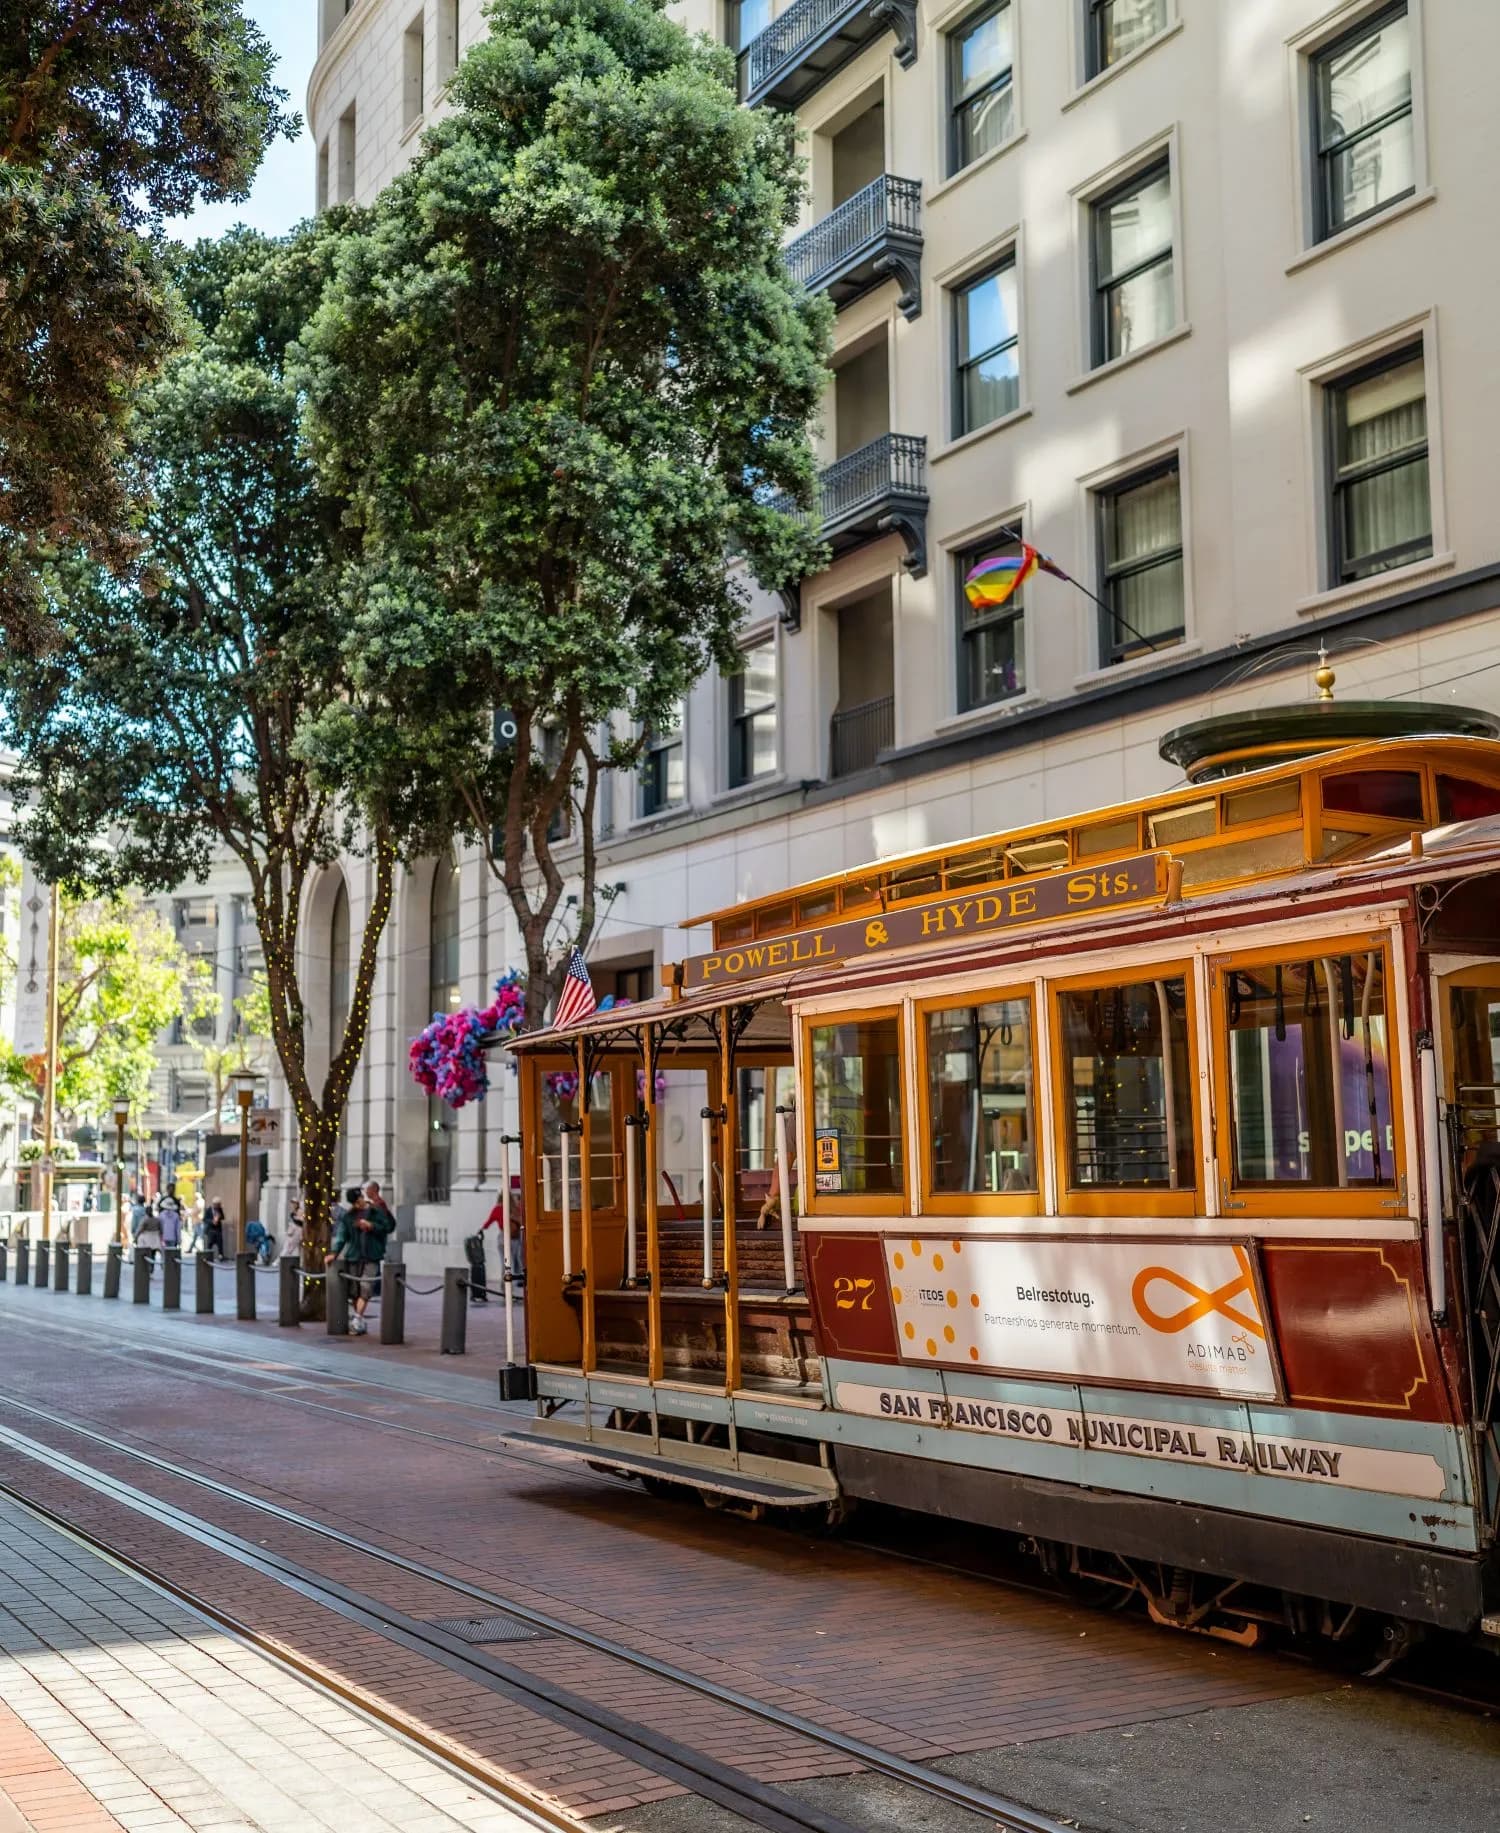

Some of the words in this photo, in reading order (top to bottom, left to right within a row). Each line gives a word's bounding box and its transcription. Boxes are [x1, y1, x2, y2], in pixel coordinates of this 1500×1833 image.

[702, 934, 836, 979] POWELL
[865, 920, 889, 948] &
[921, 887, 1037, 935] HYDE
[1067, 871, 1138, 905] Sts.
[834, 1277, 876, 1310] 27
[1016, 1286, 1095, 1308] Belrestotug.
[984, 1313, 1037, 1329] Partnerships
[1039, 1320, 1079, 1331] generate
[1081, 1321, 1141, 1336] momentum.
[1187, 1343, 1247, 1361] ADIMAB
[879, 1392, 922, 1418] SAN
[928, 1399, 1053, 1437] FRANCISCO
[1217, 1436, 1342, 1478] RAILWAY
